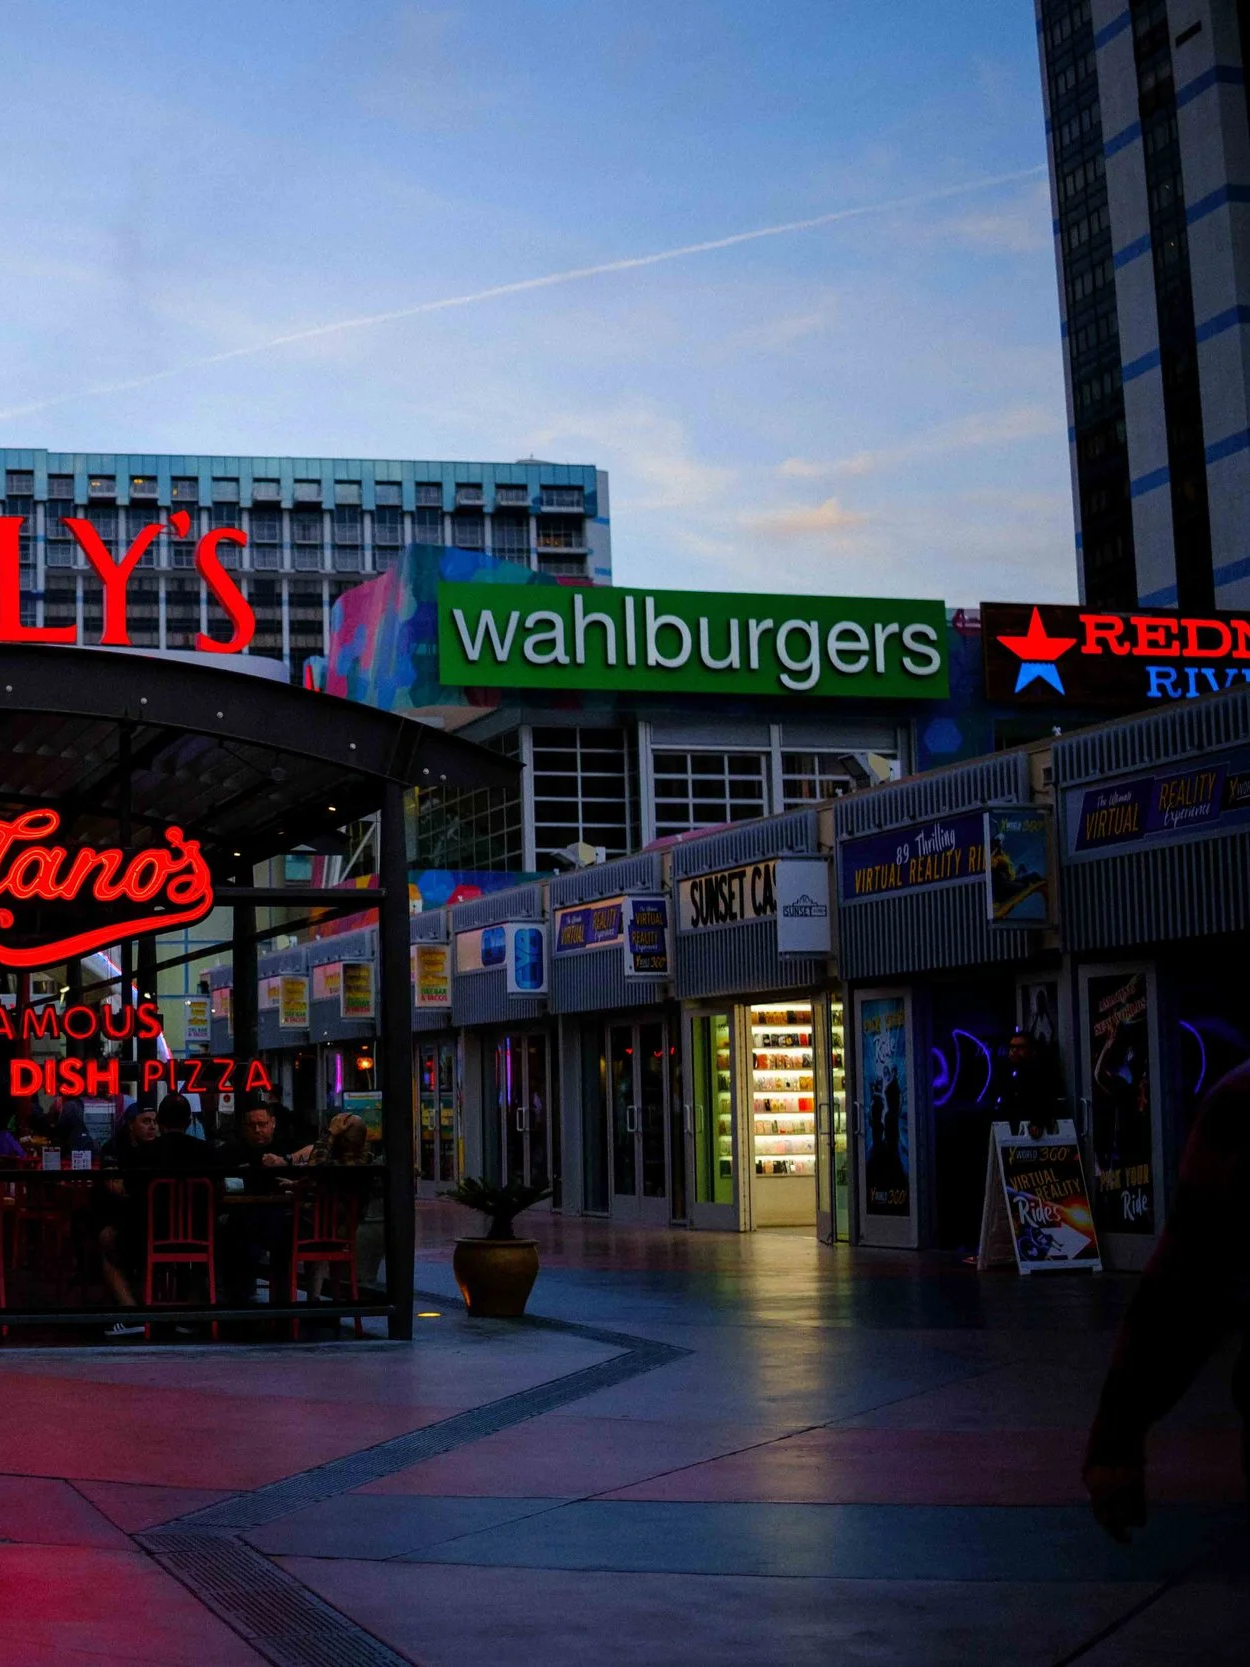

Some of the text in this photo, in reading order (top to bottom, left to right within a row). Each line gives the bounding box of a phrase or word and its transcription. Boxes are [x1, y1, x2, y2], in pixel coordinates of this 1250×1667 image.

[452, 592, 942, 691] wahlburgers
[1145, 665, 1250, 699] RIV
[1085, 771, 1217, 841] VIRTUAL REALITY
[895, 822, 956, 865] 89 Thrilling
[855, 863, 902, 895] VIRTUAL
[909, 848, 962, 886] REALITY
[690, 869, 746, 928] SUNSET
[8, 1057, 121, 1098] DISH
[142, 1057, 275, 1096] PIZZA
[1009, 1167, 1060, 1191] VIRTUAL
[1034, 1178, 1081, 1201] REALITY
[1013, 1195, 1062, 1229] Rides
[1120, 1187, 1149, 1222] Ride
